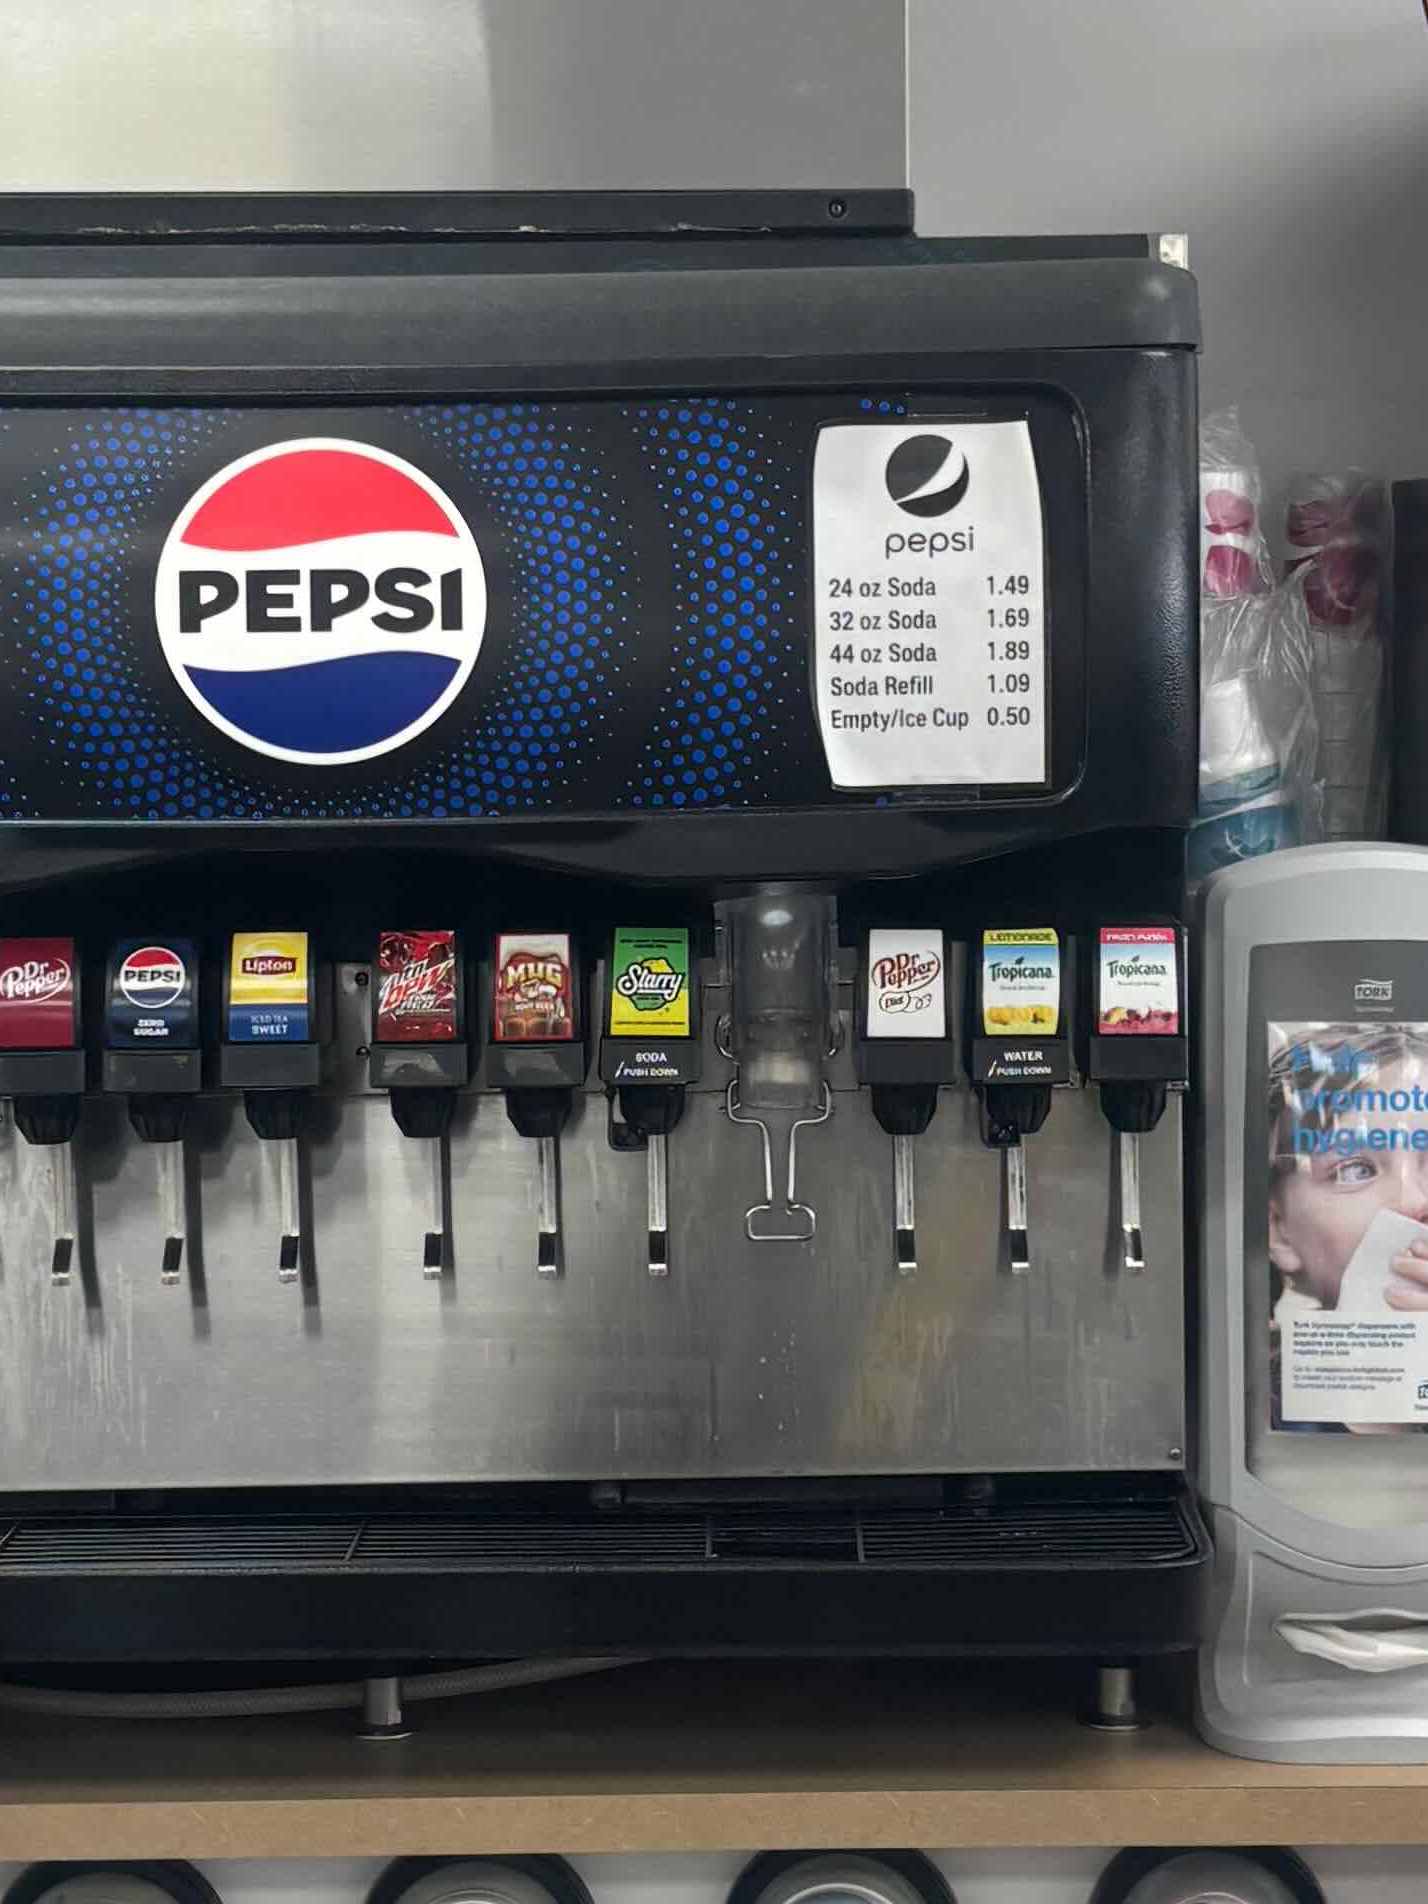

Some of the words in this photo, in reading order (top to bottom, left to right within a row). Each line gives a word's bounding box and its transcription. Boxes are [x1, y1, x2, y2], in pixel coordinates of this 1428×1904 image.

[886, 526, 974, 559] pepsi
[829, 579, 853, 598] 24
[860, 583, 881, 598] oz
[888, 577, 936, 597] Soda
[987, 575, 1029, 595] 1.49
[179, 567, 463, 634] PEPSI
[829, 611, 853, 631] 32
[860, 616, 881, 630] oz
[888, 610, 936, 630] Soda
[987, 608, 1029, 628] 1.69
[829, 644, 853, 663] 44
[860, 649, 881, 664] oz
[888, 643, 936, 662] Soda
[987, 641, 1029, 661] 1.89
[831, 677, 878, 697] Soda
[885, 675, 933, 695] Refill
[987, 673, 1029, 693] 1.09
[831, 708, 926, 732] Empty/Ice
[933, 707, 969, 731] Cup
[987, 706, 1030, 727] 0.50
[24, 961, 49, 980] Dr
[245, 958, 293, 975] Lipton
[895, 952, 920, 970] Dr
[989, 960, 1053, 982] Tropicana
[1107, 959, 1167, 978] Tropicana
[124, 970, 180, 984] PEPSI
[507, 962, 562, 990] MUG
[874, 957, 936, 989] Pepper
[1357, 985, 1390, 998] TORK
[252, 1024, 288, 1035] SWEET
[635, 1052, 668, 1063] SODA
[1003, 1051, 1043, 1062] WATER
